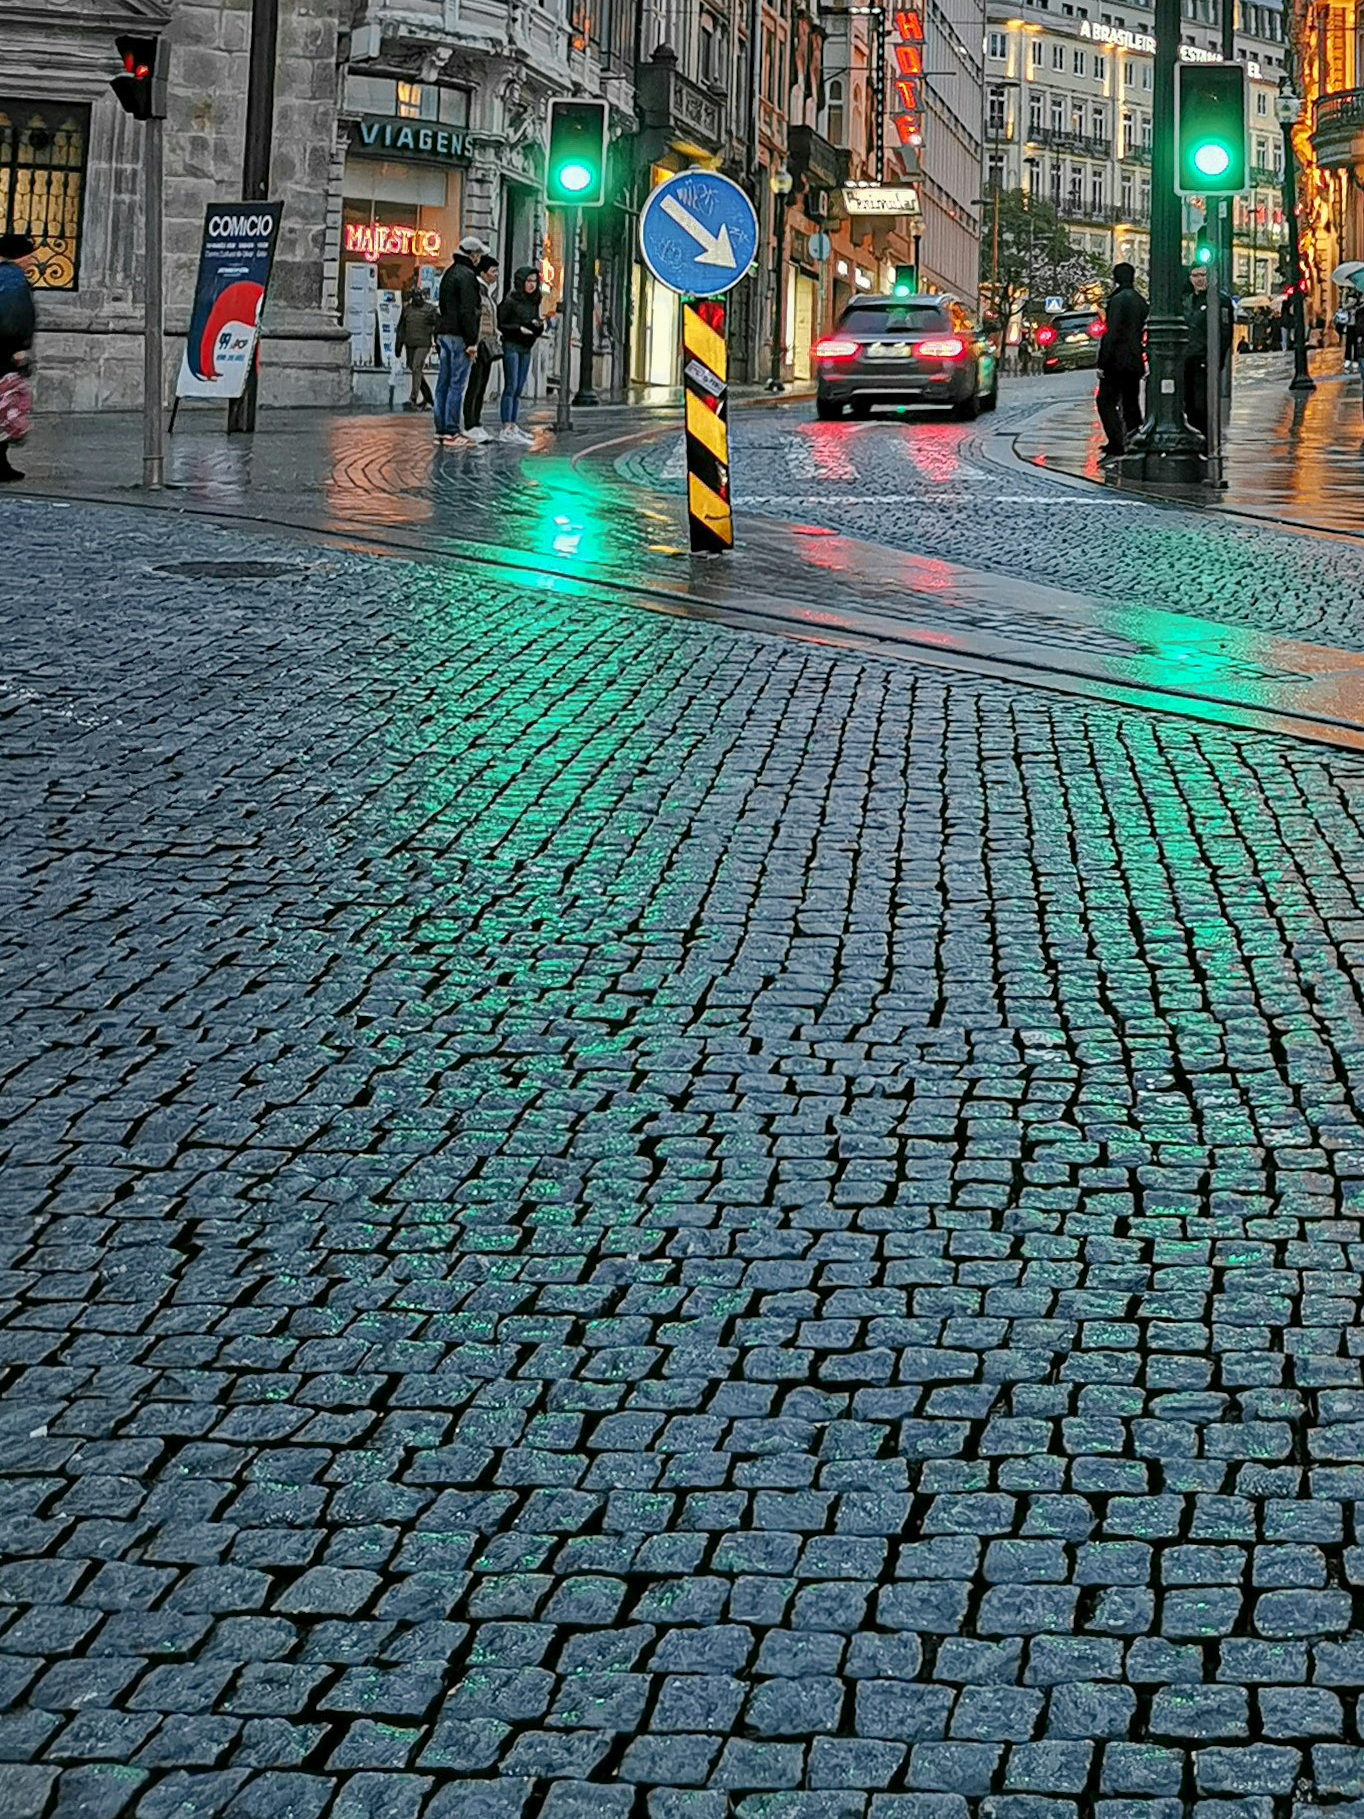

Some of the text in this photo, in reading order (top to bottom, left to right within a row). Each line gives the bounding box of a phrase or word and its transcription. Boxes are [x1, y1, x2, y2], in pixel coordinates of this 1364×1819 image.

[1080, 20, 1092, 38] A
[1092, 22, 1157, 55] BRASILEIR
[360, 122, 474, 157] VIAGENS
